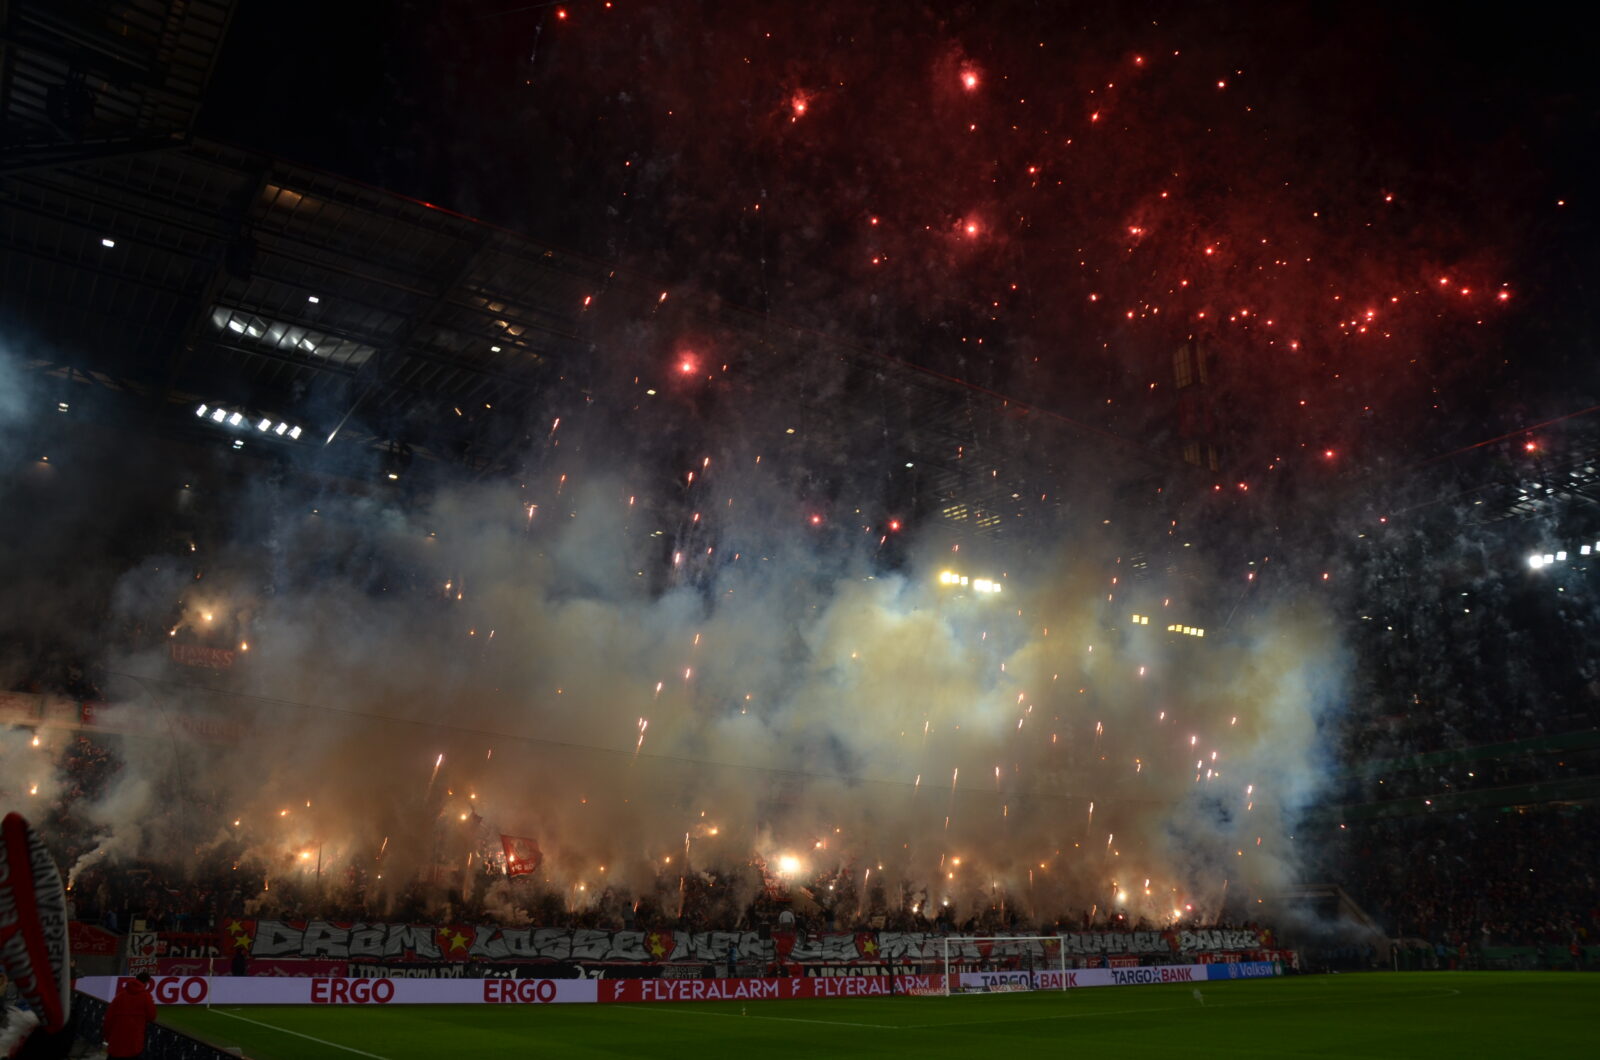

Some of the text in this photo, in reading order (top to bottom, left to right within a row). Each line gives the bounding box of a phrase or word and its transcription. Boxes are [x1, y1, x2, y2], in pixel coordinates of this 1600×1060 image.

[311, 978, 395, 1003] ERGO
[484, 979, 557, 1003] ERGO
[641, 979, 779, 1000] FLYERALARM
[814, 975, 930, 996] FLYERALARM
